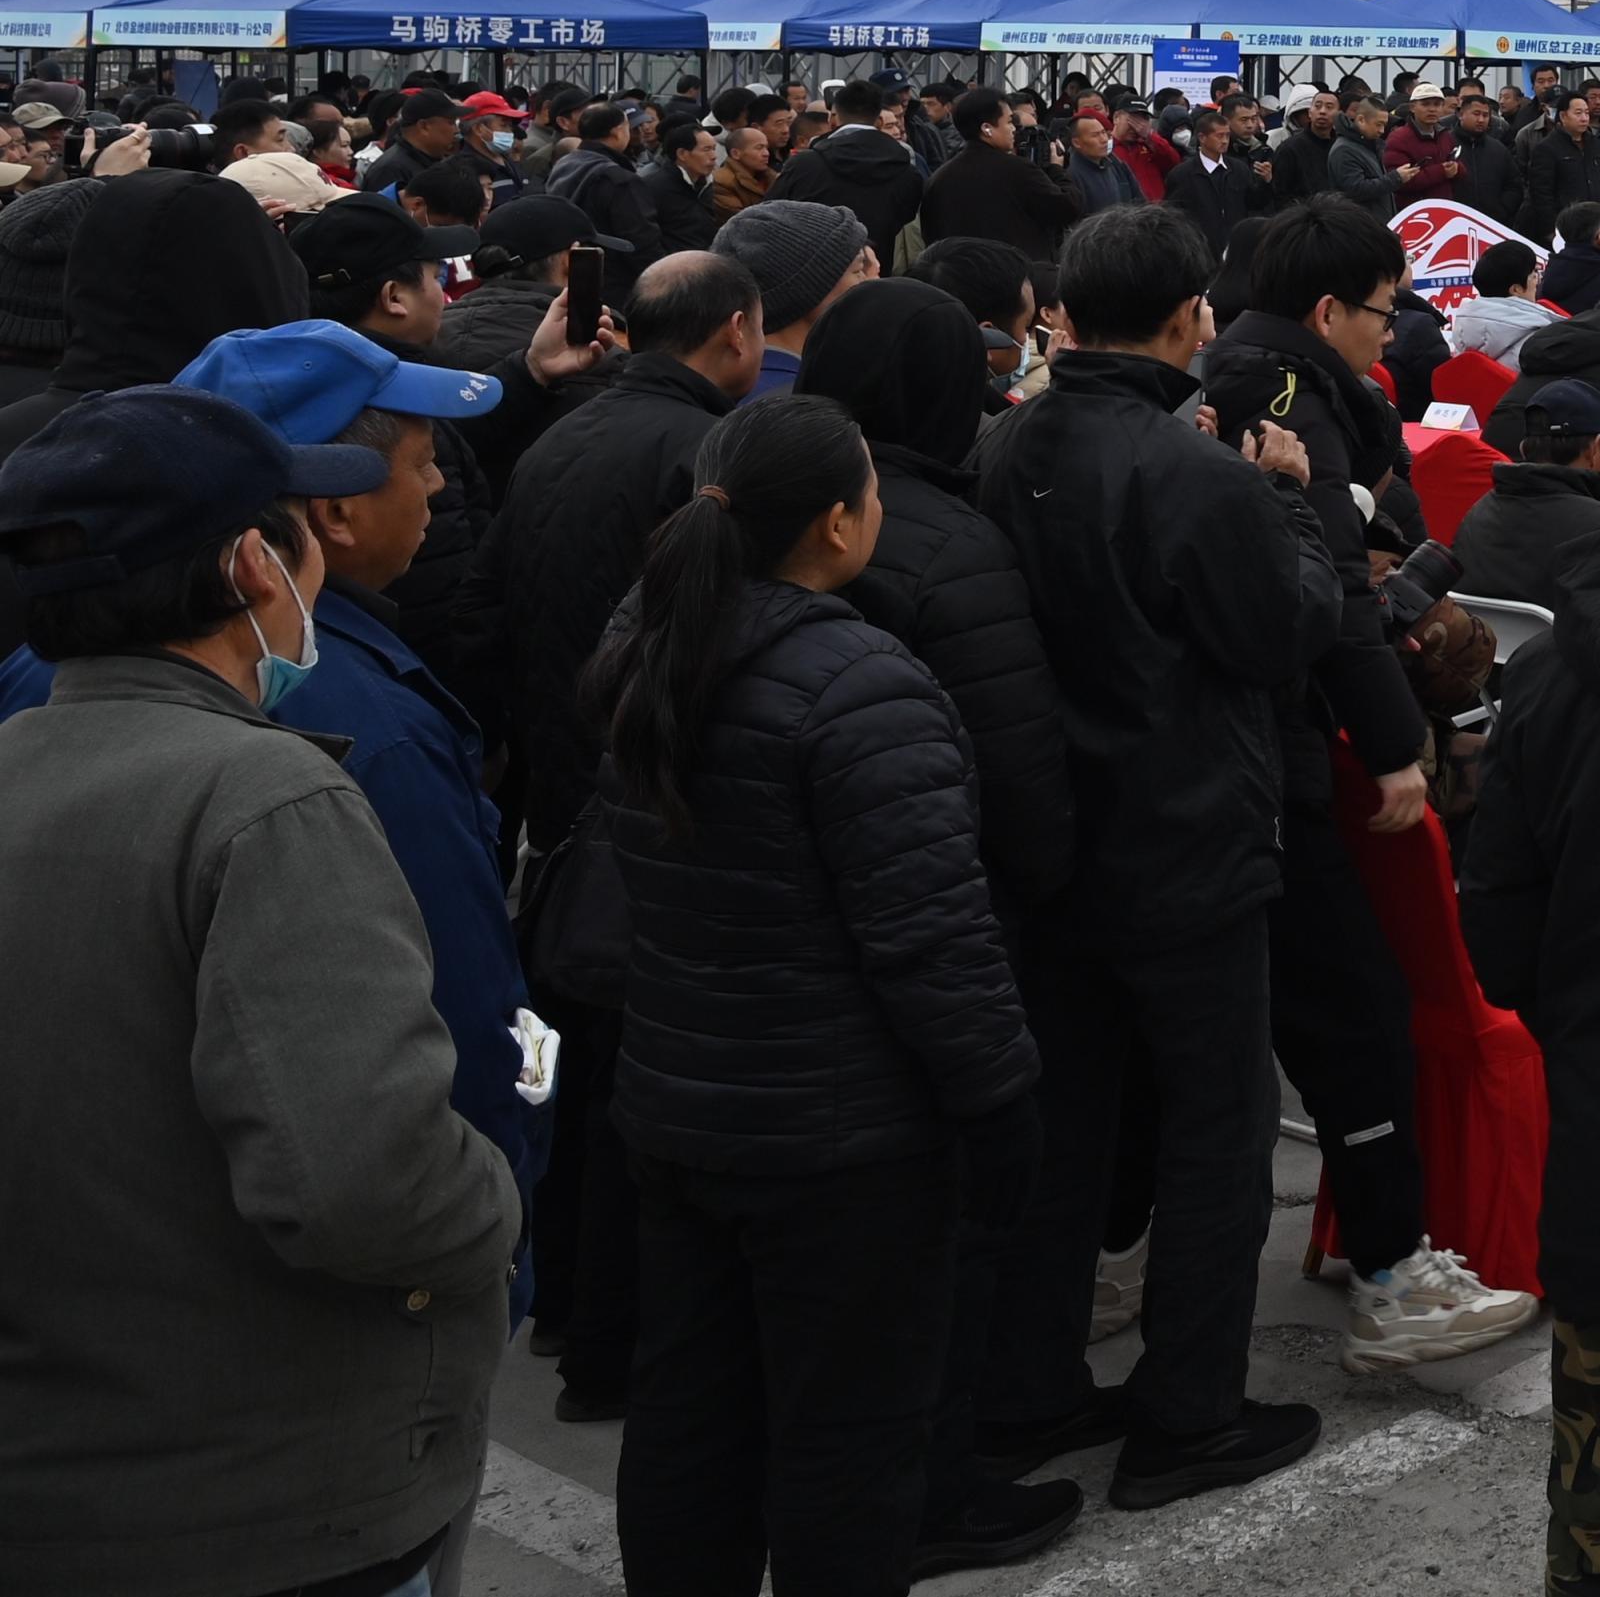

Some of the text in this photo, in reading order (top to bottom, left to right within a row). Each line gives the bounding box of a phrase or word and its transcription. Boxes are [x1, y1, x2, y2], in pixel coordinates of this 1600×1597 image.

[390, 15, 605, 45] 马驹桥零工市场
[828, 25, 930, 48] 马驹桥零工市场
